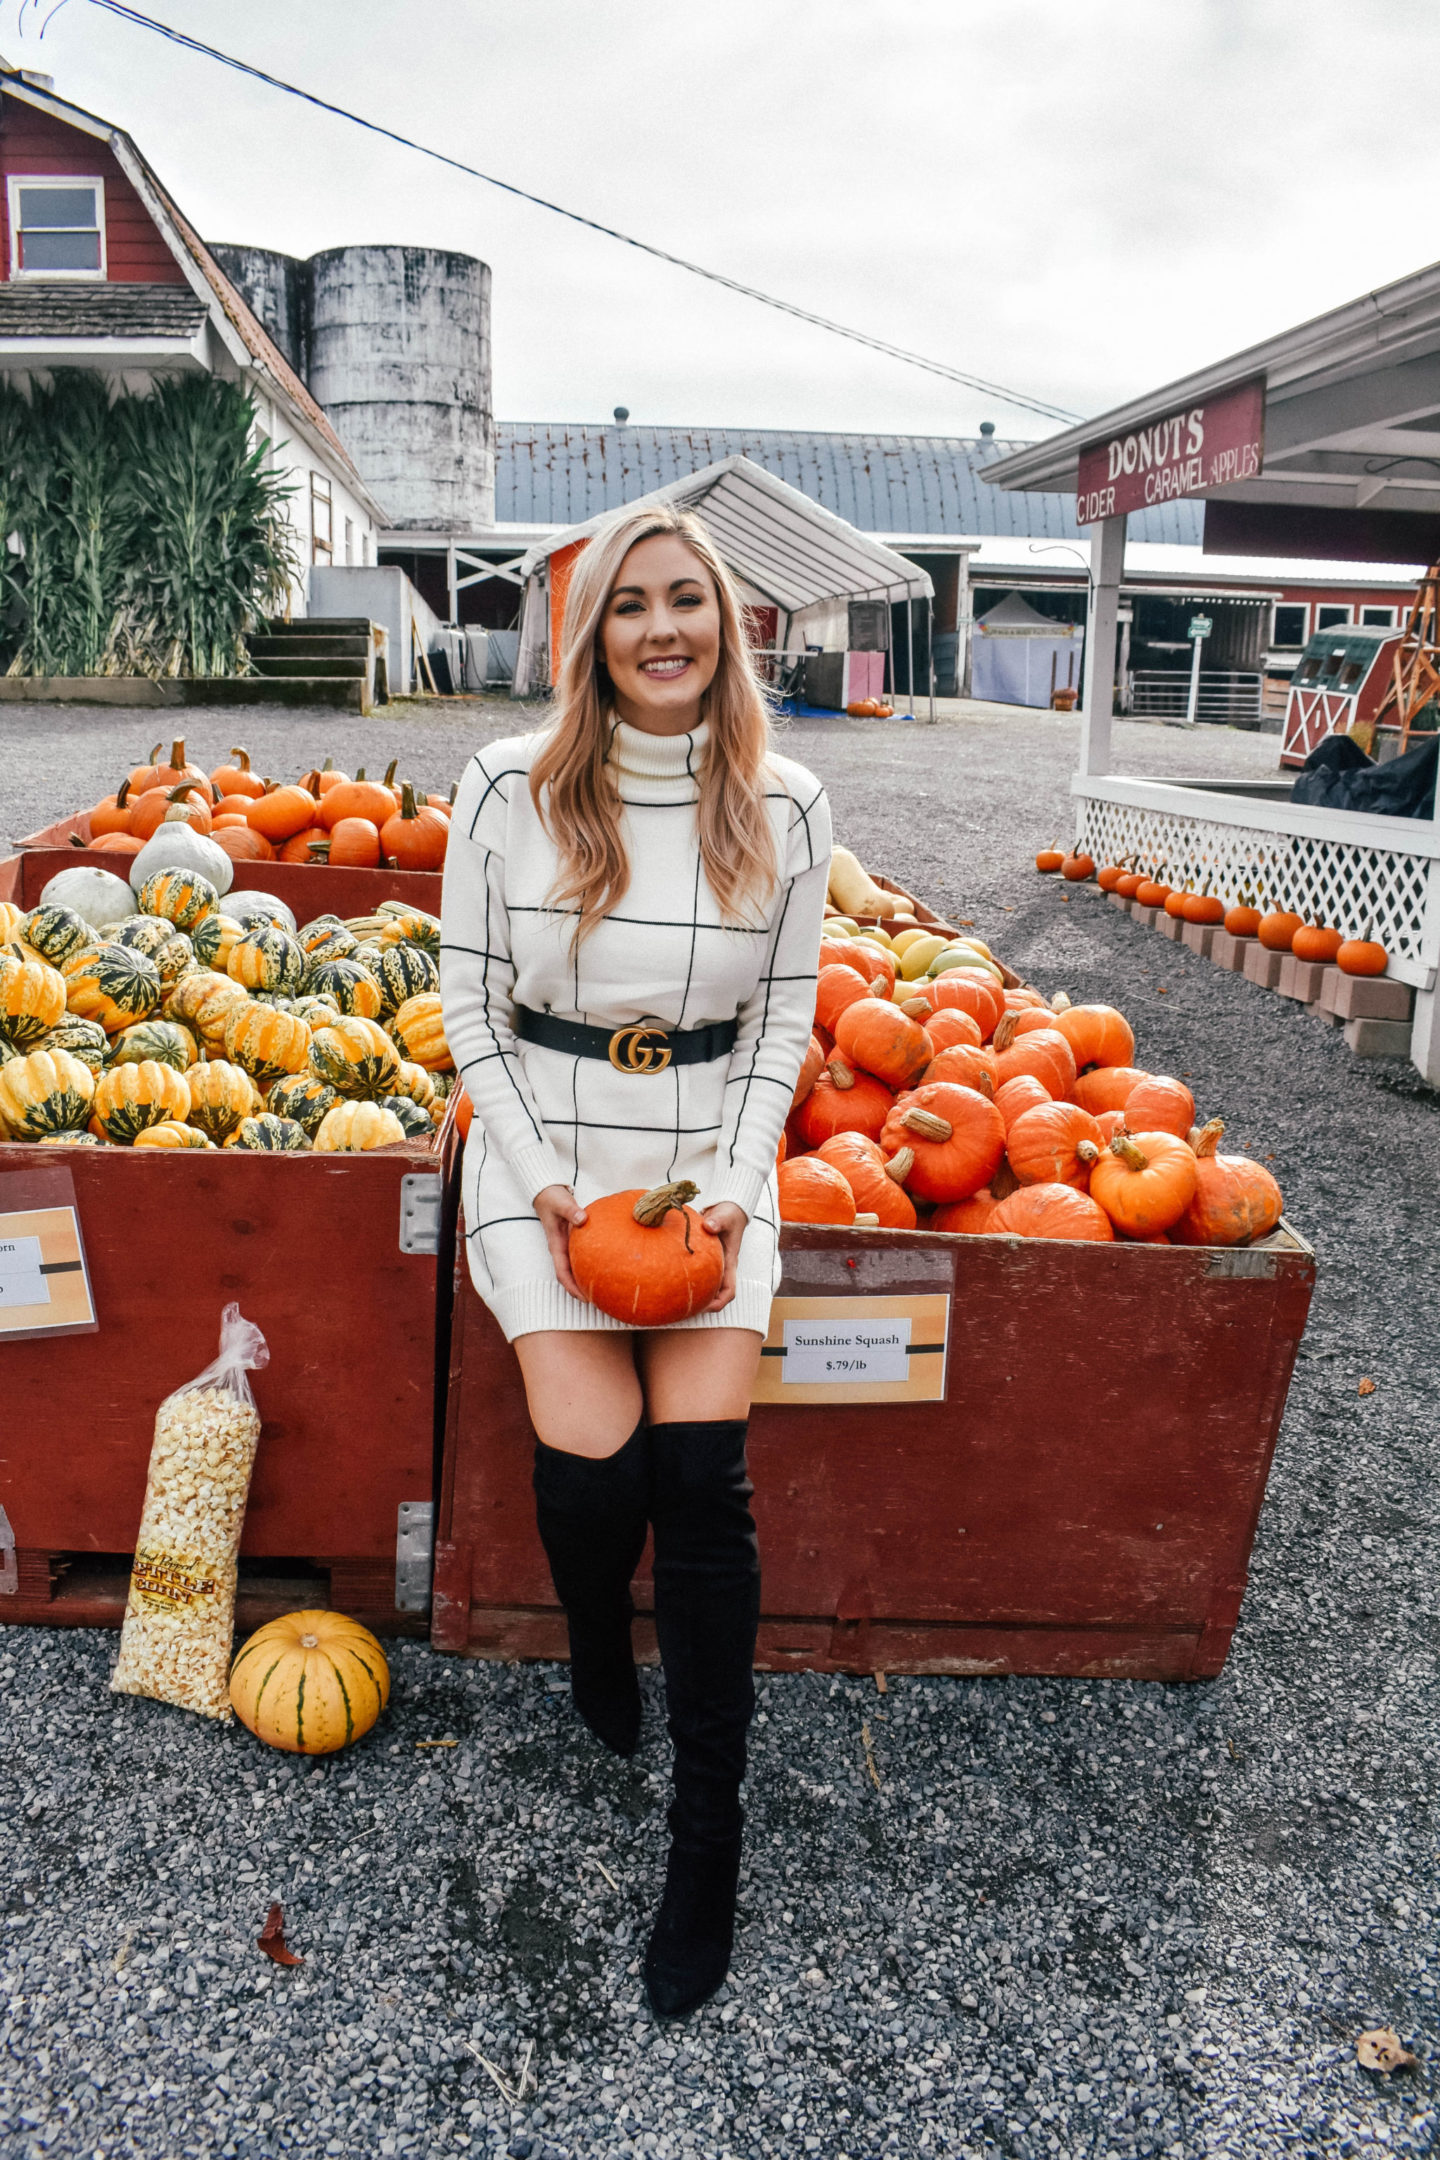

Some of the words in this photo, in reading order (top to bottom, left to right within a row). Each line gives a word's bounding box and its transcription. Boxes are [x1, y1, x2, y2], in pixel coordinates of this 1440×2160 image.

[1107, 409, 1204, 482] DONUTS
[1144, 457, 1207, 503] CARAMEL
[1209, 443, 1259, 485] APPLES
[1076, 486, 1116, 523] CIDER
[795, 1335, 852, 1346] Sunshine
[855, 1334, 899, 1347] Squash
[826, 1360, 867, 1371] $.79/lb
[135, 1577, 192, 1604] CORN
